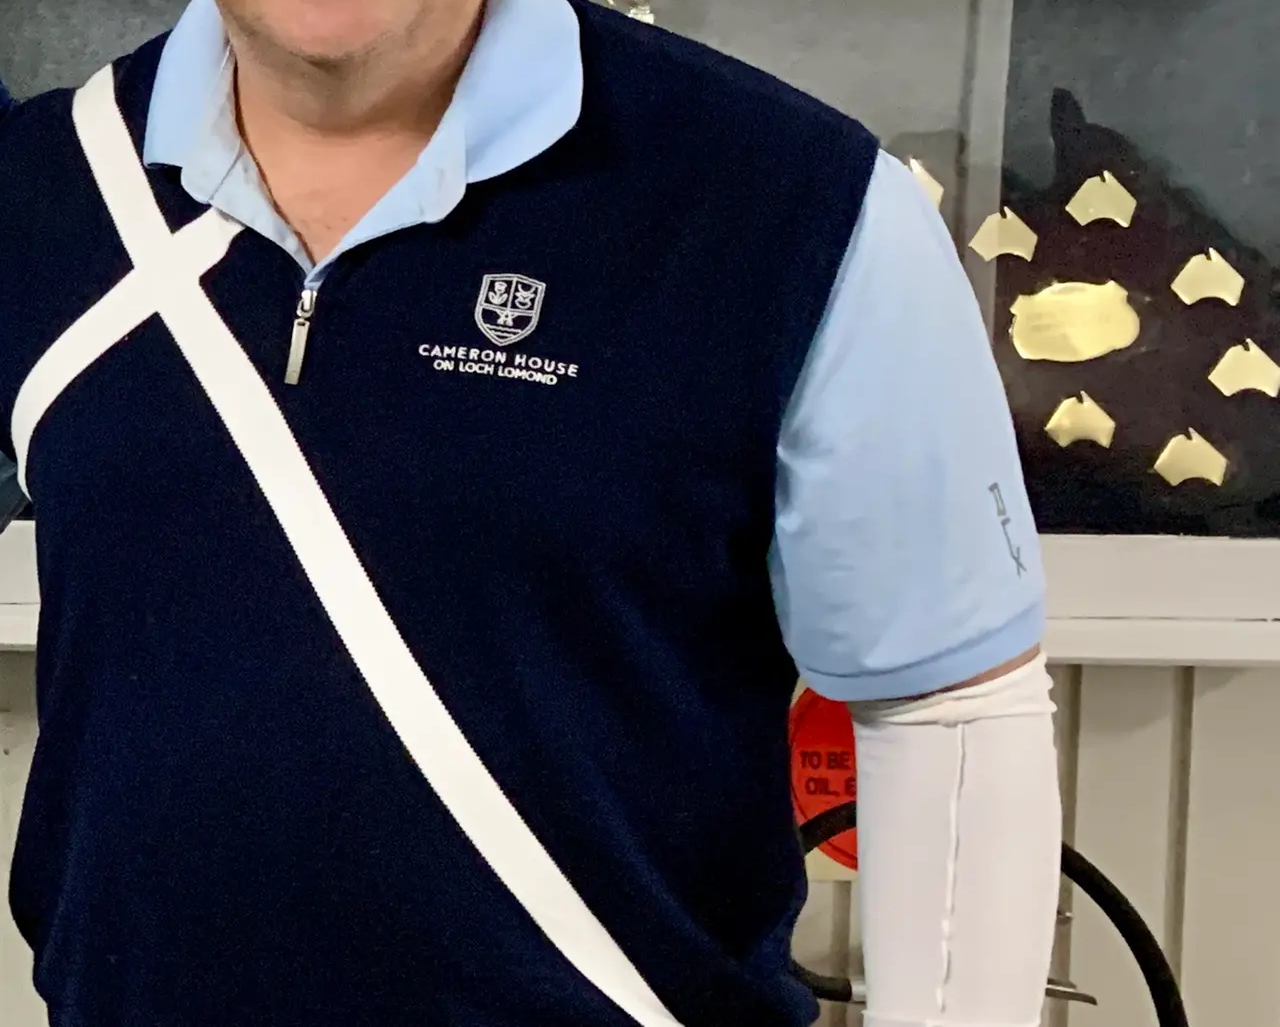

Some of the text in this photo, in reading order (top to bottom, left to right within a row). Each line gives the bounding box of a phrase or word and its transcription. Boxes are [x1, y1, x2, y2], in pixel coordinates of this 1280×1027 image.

[418, 343, 580, 378] CAMERON HOUSE
[433, 359, 558, 386] ON LOCH LOMOND
[800, 750, 852, 770] TO BE
